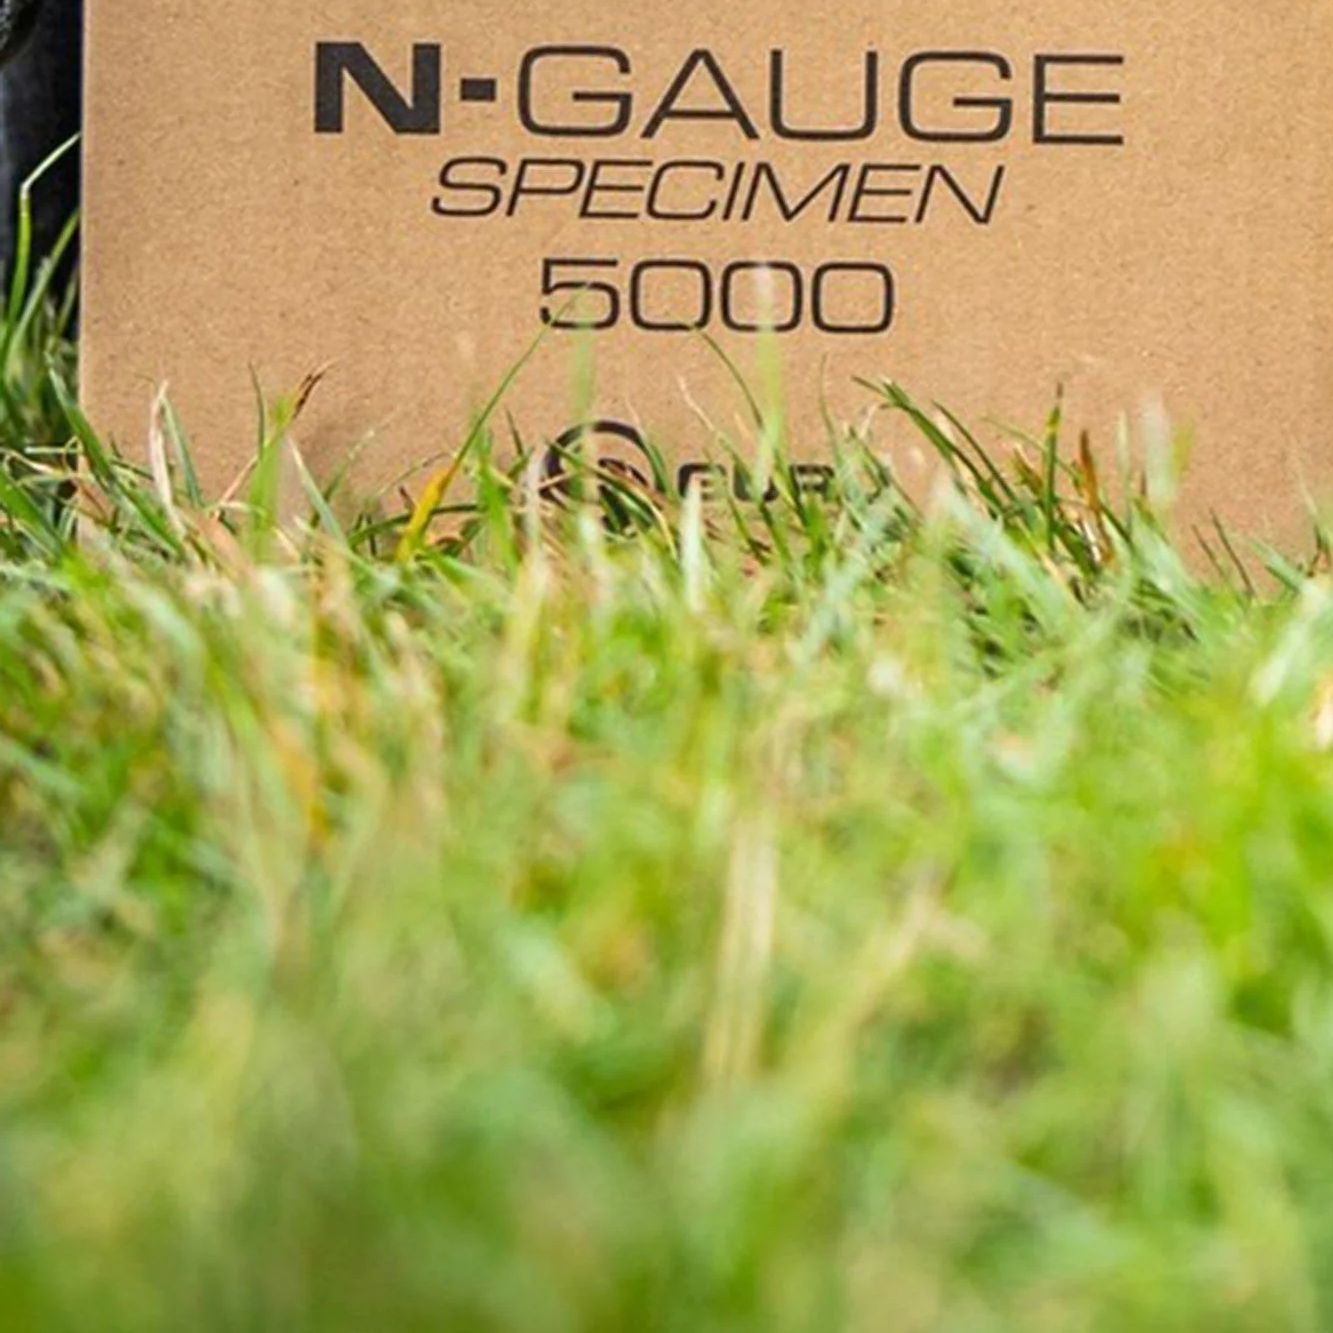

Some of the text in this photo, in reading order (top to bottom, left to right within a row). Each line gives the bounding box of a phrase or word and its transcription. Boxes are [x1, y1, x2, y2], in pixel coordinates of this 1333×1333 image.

[313, 40, 1125, 145] N-GAUGE
[430, 155, 1005, 225] SPECIMEN
[539, 257, 896, 335] 5000
